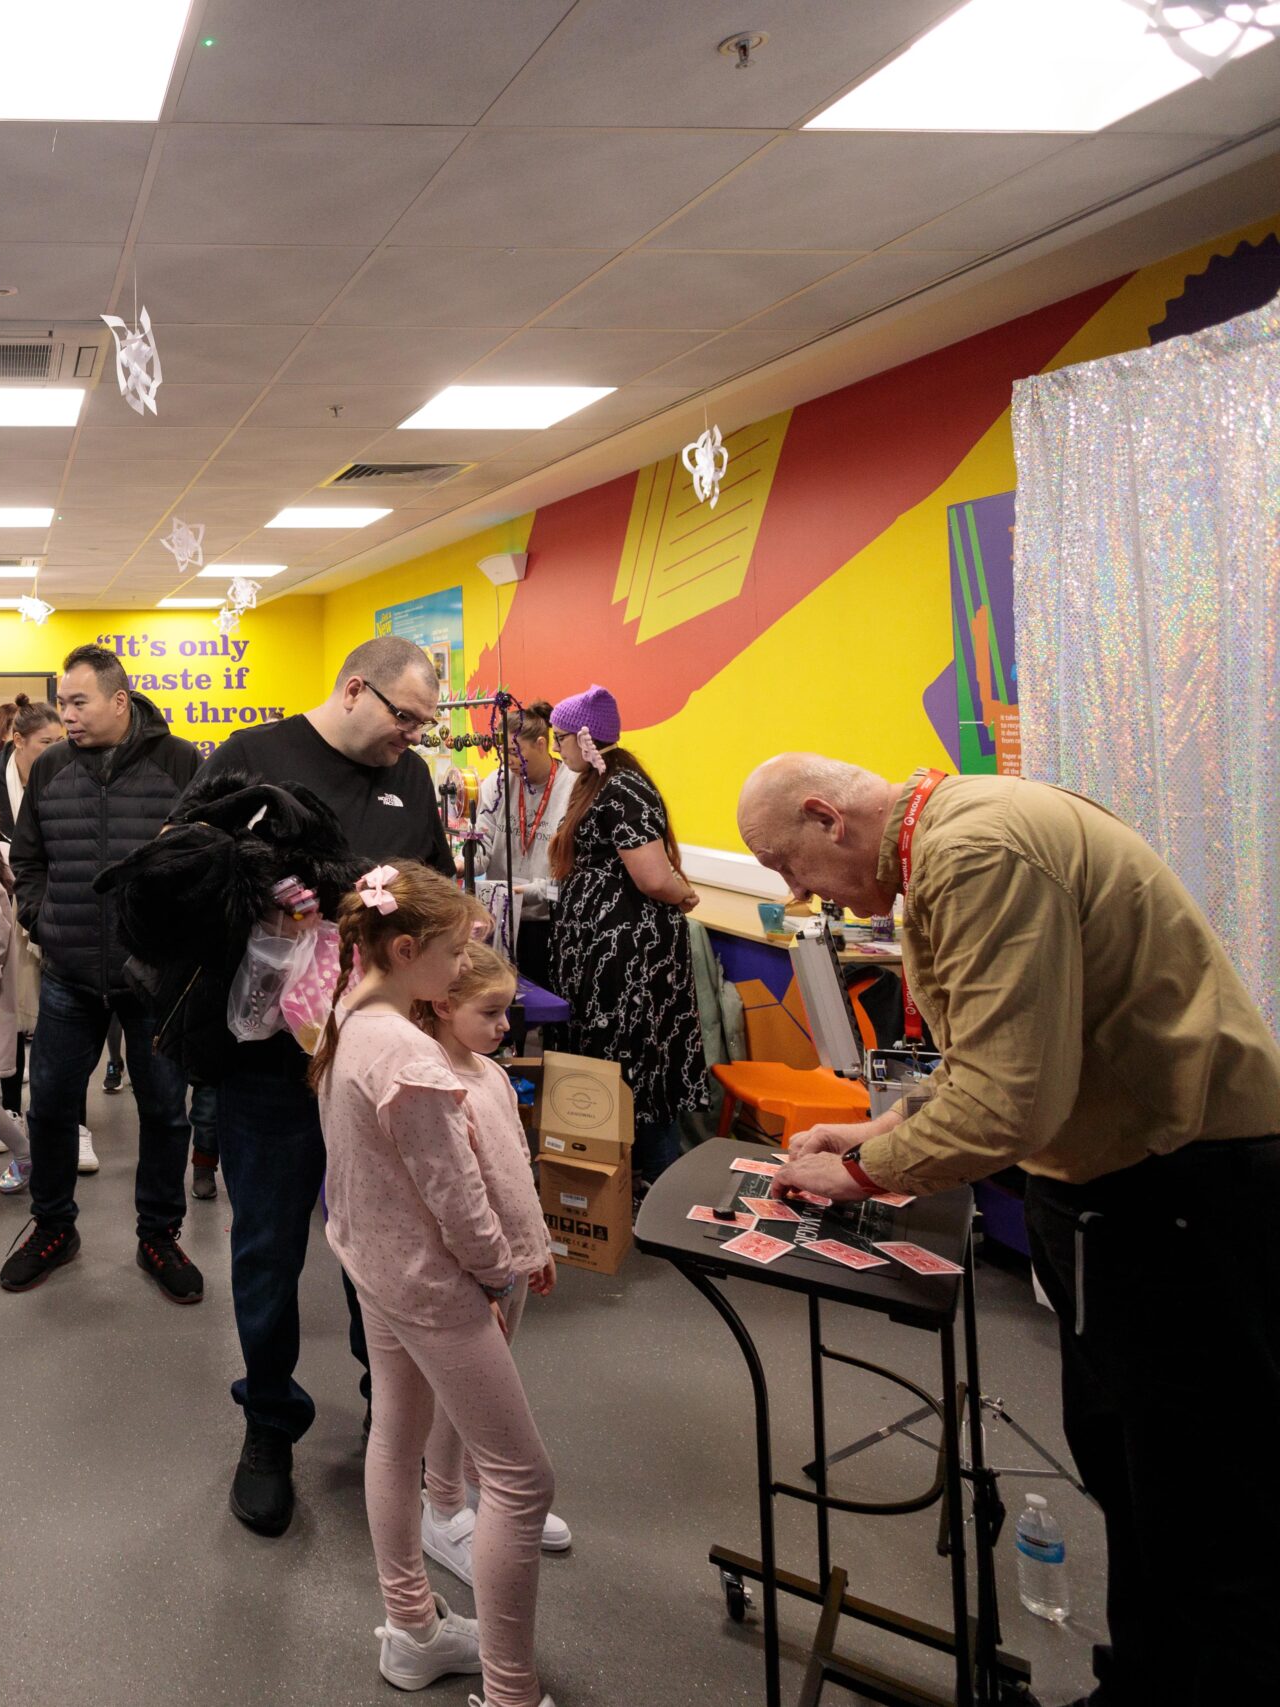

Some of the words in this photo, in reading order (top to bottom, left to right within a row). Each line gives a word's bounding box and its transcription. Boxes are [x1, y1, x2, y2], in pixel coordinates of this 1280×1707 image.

[179, 634, 250, 662] only
[223, 667, 250, 690] if
[185, 702, 285, 724] throw
[910, 794, 922, 817] VEOLIA
